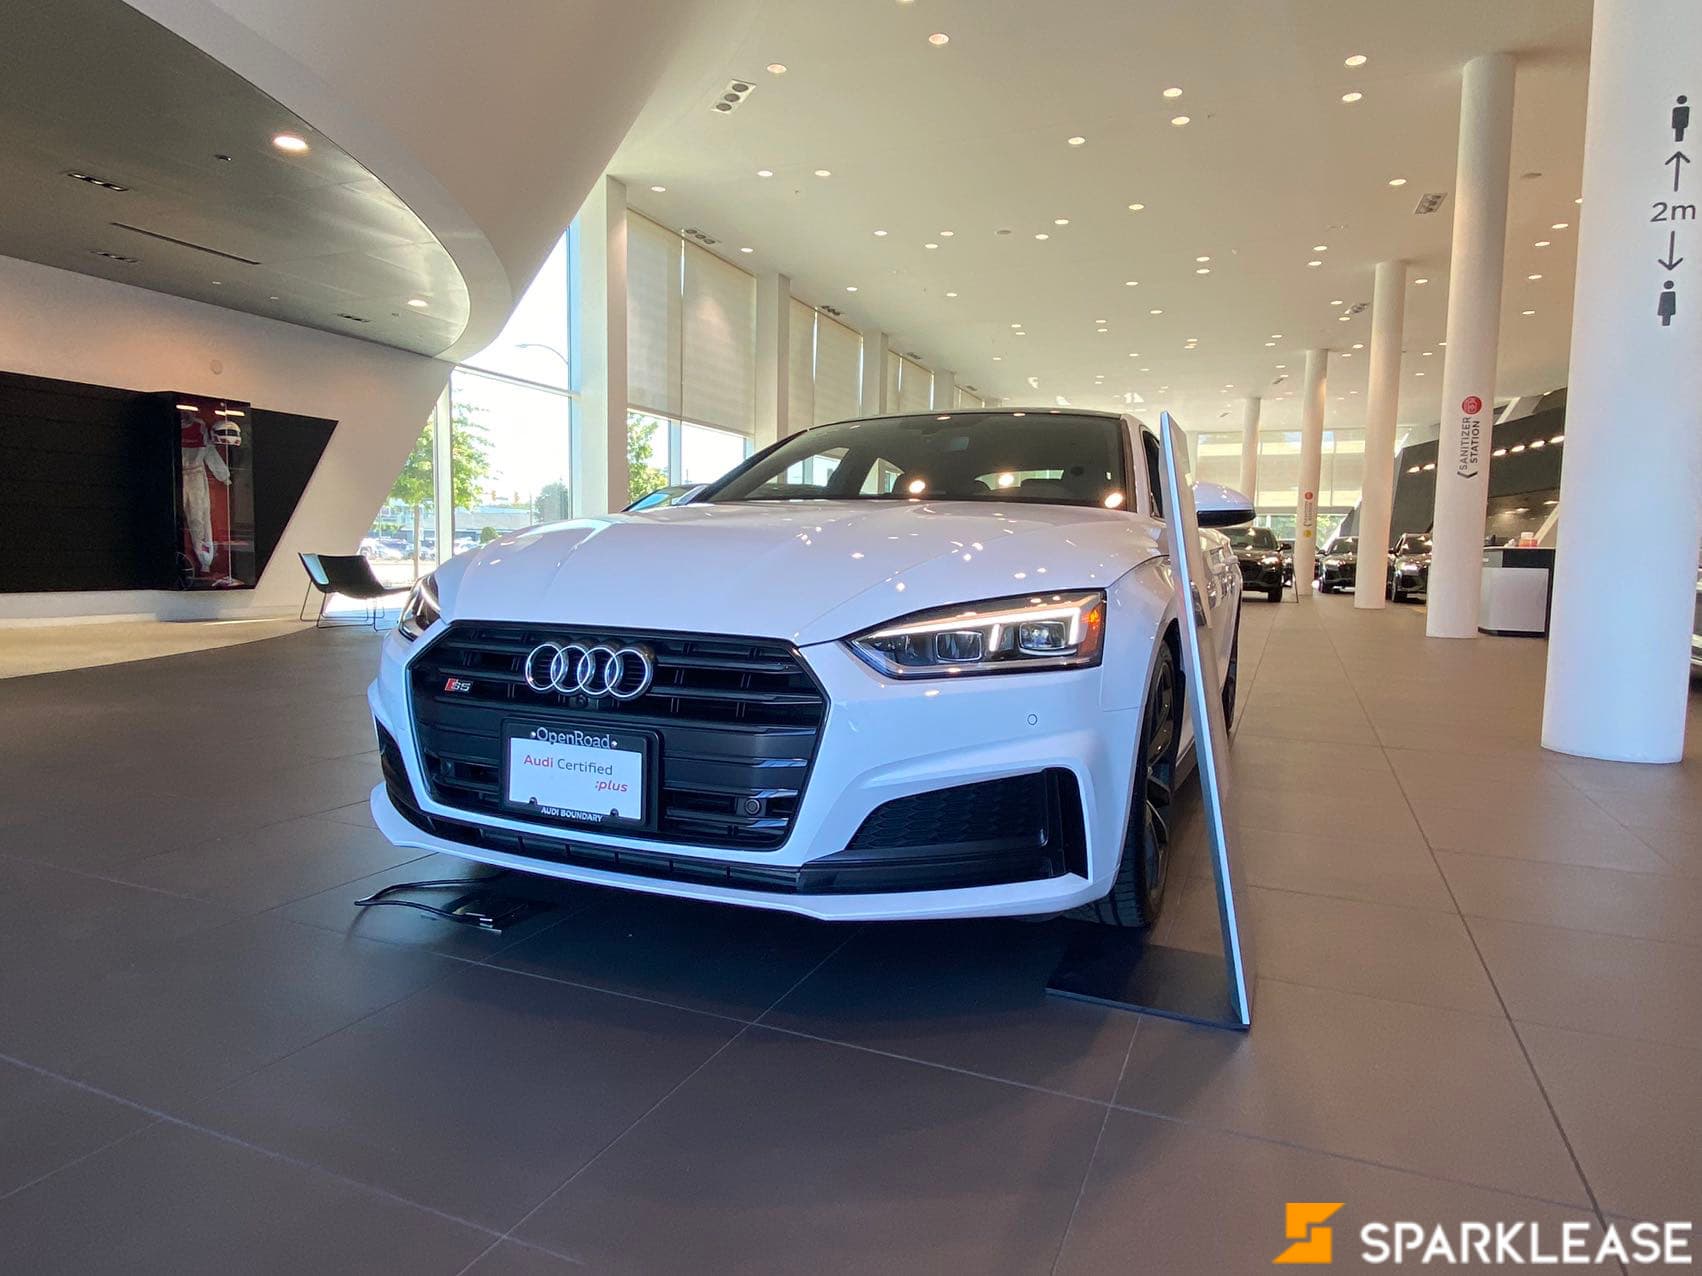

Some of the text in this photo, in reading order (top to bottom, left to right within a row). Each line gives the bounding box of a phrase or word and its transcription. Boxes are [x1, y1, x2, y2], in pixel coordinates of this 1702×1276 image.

[1650, 202, 1696, 222] 2m
[1460, 416, 1472, 471] SANITIZER
[1469, 420, 1480, 464] STATION
[450, 679, 471, 692] S5
[536, 727, 610, 750] OpenRoad
[524, 755, 613, 776] Audi Certified
[540, 806, 603, 822] AUDI BOUNDARY
